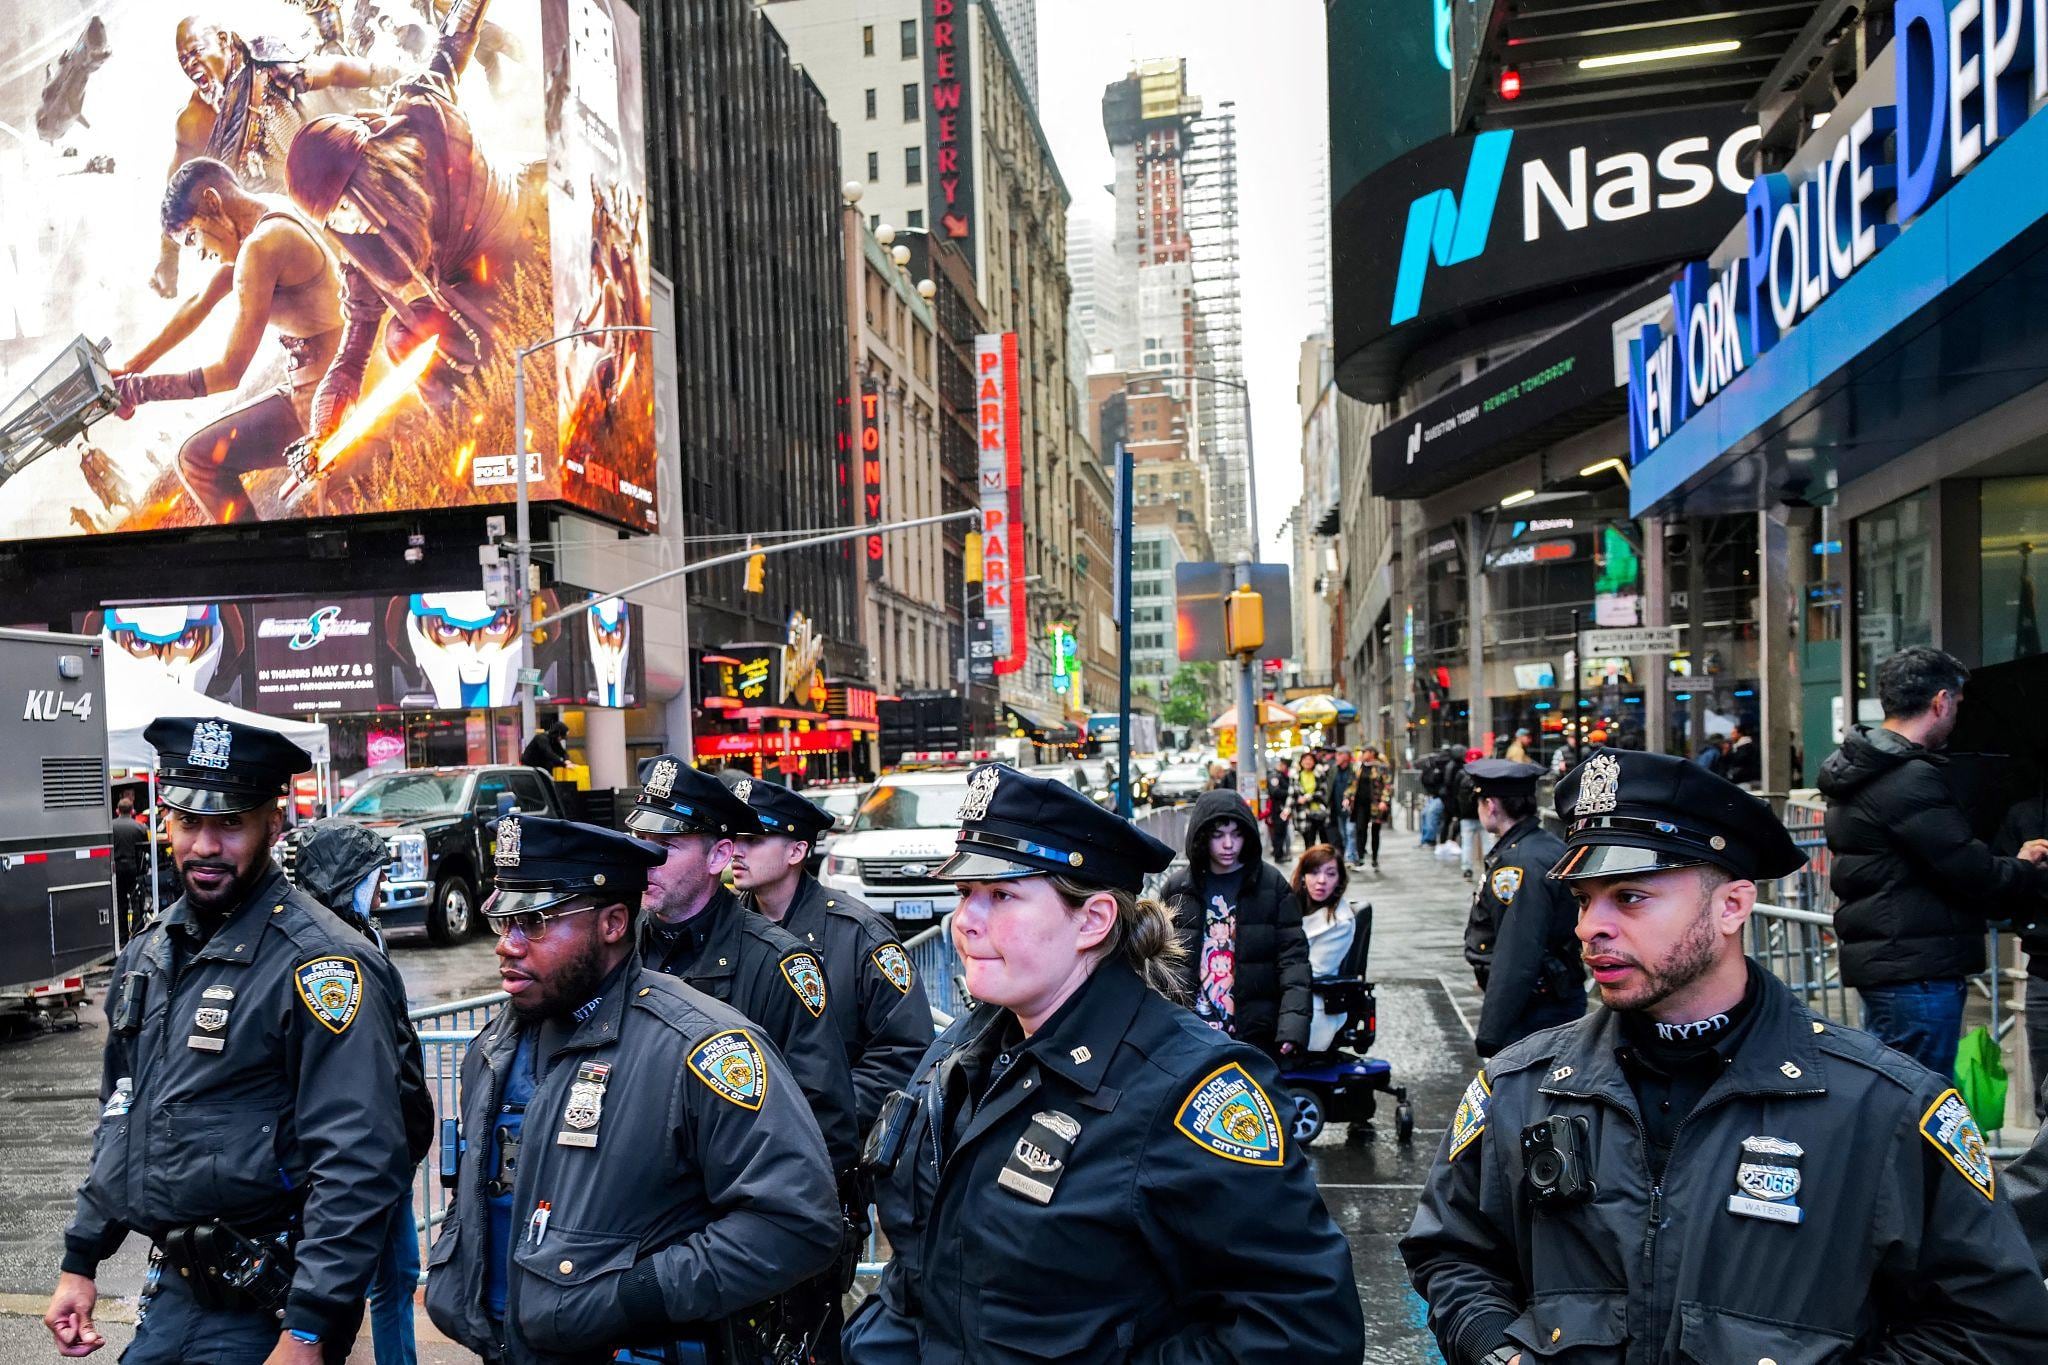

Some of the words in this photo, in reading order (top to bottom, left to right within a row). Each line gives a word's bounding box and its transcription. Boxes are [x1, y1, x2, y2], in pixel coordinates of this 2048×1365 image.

[1669, 256, 1744, 422] YORK
[1745, 106, 1877, 356] POLICE
[980, 353, 999, 450] PARK
[1456, 404, 1480, 426] TODAY
[862, 394, 883, 560] TONYS
[984, 509, 1006, 607] PARK
[259, 670, 270, 680] IN
[271, 668, 310, 680] THEATERS
[311, 664, 339, 678] MAY
[341, 664, 350, 677] 7
[351, 663, 362, 676] &
[364, 663, 373, 676] 8
[22, 689, 93, 722] KU-4
[311, 961, 344, 973] POLICE
[719, 958, 727, 966] 6
[302, 968, 356, 985] DEPARTMENT
[305, 992, 321, 1010] CITY
[319, 1010, 332, 1021] OF
[1655, 1013, 1730, 1041] NYPD
[699, 1041, 750, 1071] DEPARTMENT
[702, 1036, 735, 1057] POLICE
[751, 1051, 763, 1076] YORK
[709, 1077, 731, 1095] CITY
[730, 1091, 745, 1101] OF
[1192, 1076, 1228, 1113] POLICE
[1192, 1078, 1249, 1135] DEPARTMENT
[1251, 1089, 1273, 1121] YORK
[1211, 1138, 1241, 1156] CITY
[1243, 1148, 1262, 1159] OF
[1456, 1126, 1478, 1147] YORK
[1744, 1172, 1792, 1194] 25066
[1745, 1202, 1787, 1217] WATERS
